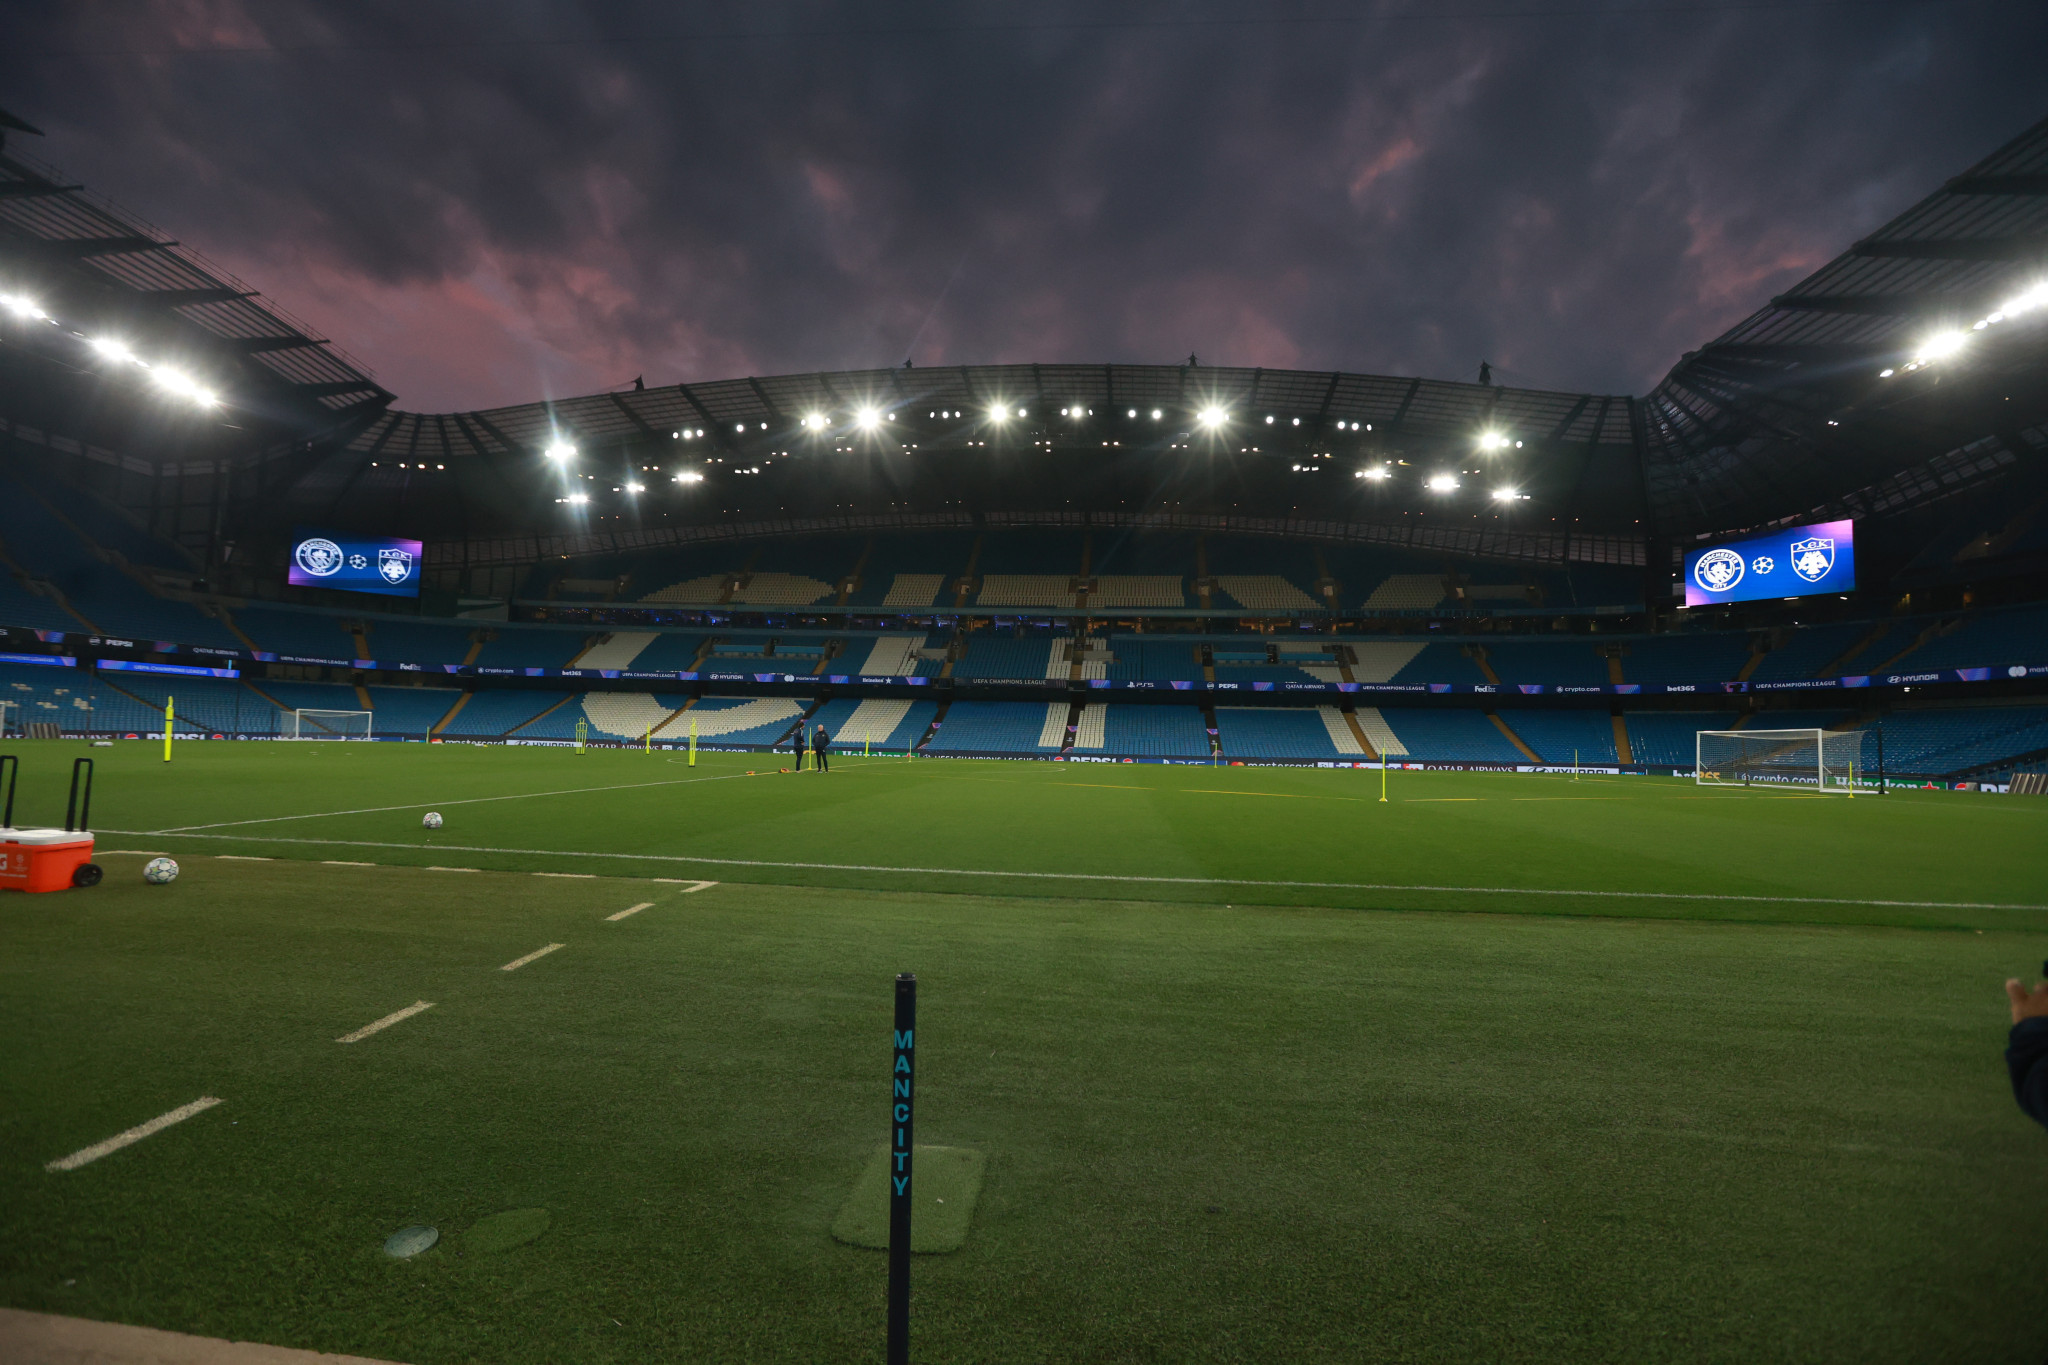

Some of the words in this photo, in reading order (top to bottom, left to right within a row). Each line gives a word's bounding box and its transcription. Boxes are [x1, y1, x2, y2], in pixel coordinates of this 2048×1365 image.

[1700, 552, 1739, 568] MANCHESTER
[106, 639, 133, 647] PEPSI
[1753, 775, 1818, 784] cryptocom
[892, 1030, 912, 1196] MANCITY
